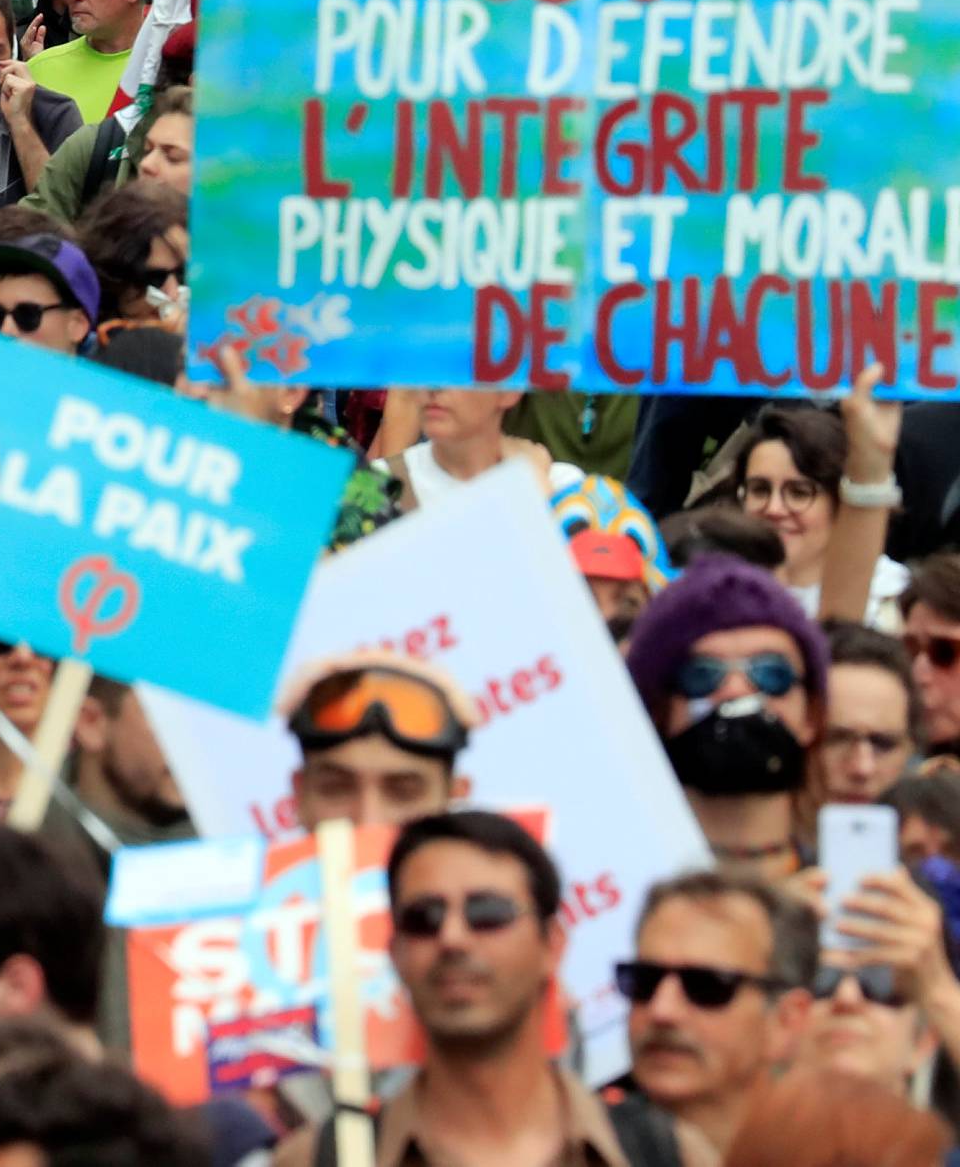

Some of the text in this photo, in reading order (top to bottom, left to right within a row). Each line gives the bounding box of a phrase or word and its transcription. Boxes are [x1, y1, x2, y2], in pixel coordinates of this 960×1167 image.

[302, 89, 830, 203] L'INTEGRITE
[277, 195, 579, 289] PHYSIQUE
[602, 197, 689, 283] ET
[472, 281, 573, 390] DE
[47, 394, 242, 507] POUR
[93, 483, 255, 585] PAIX
